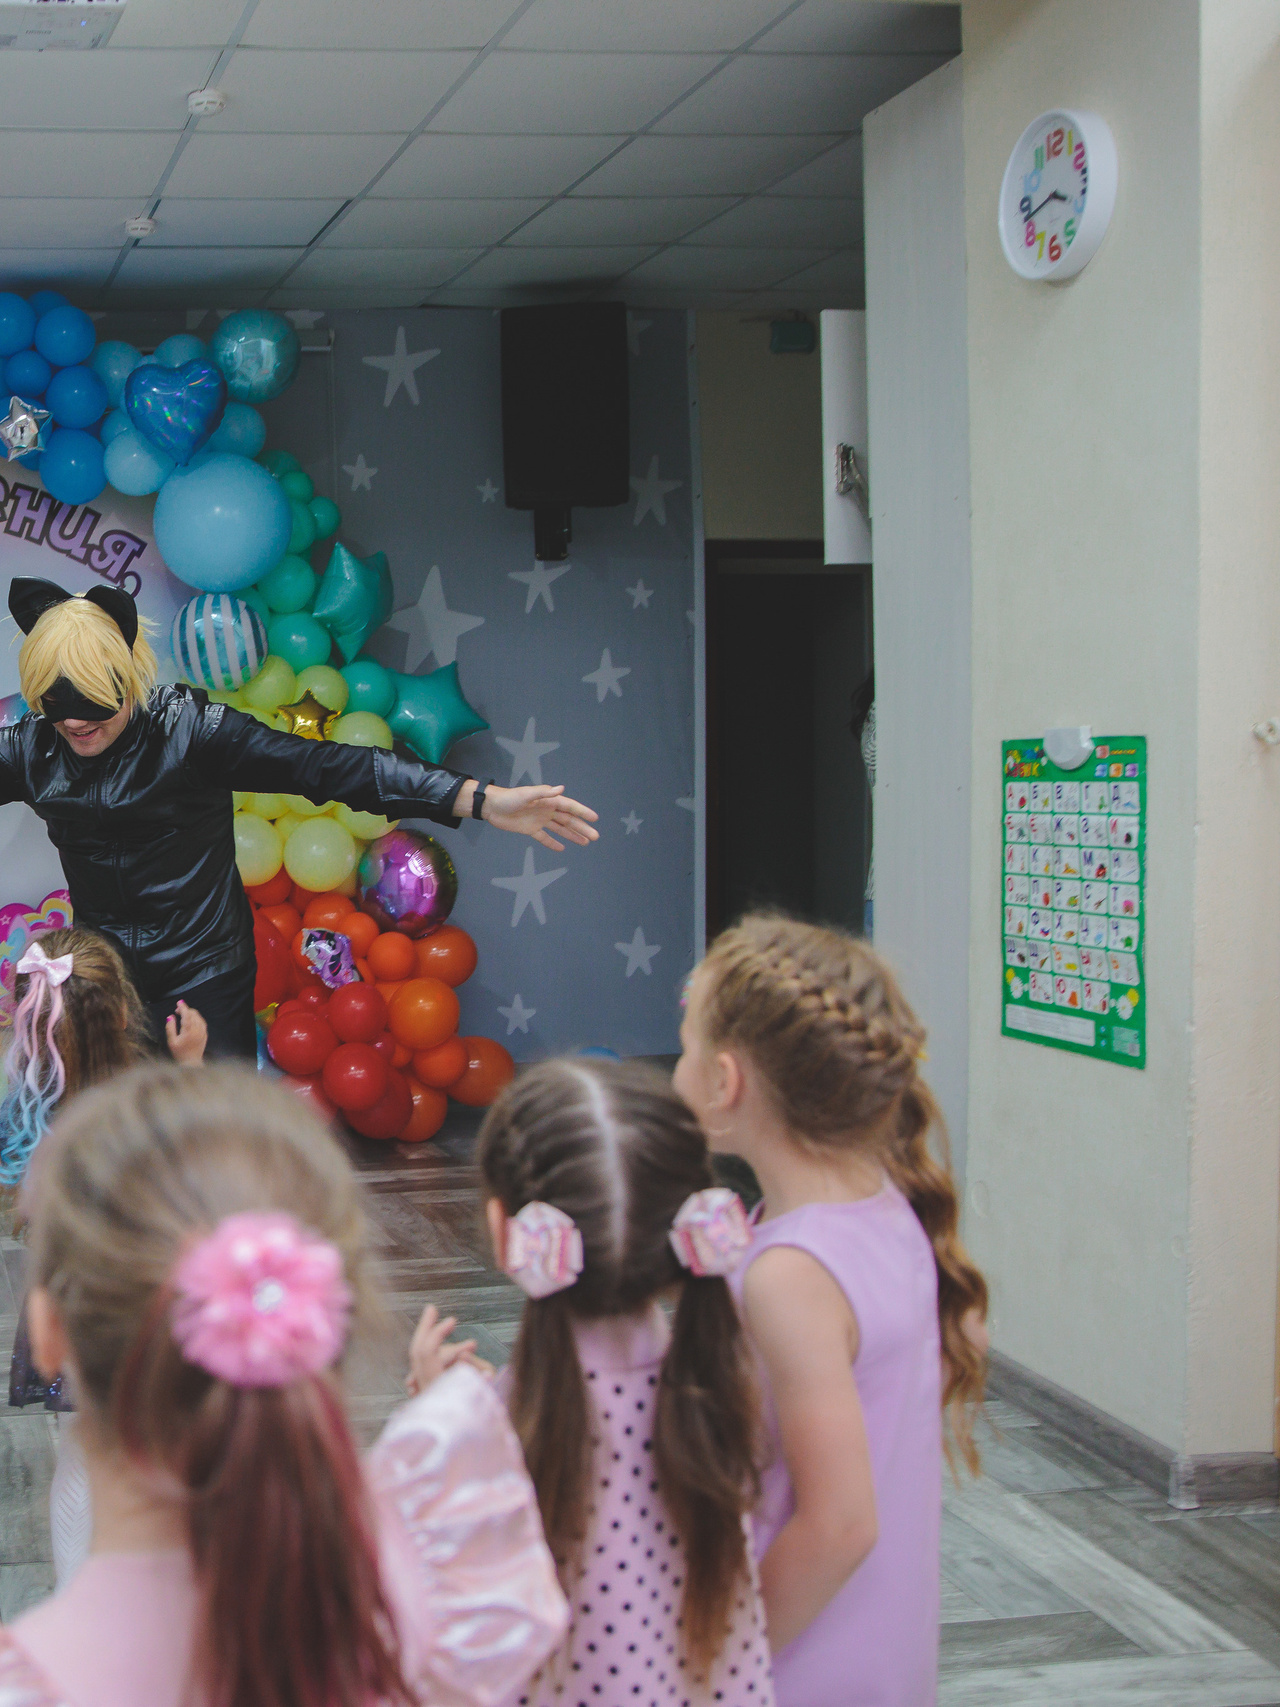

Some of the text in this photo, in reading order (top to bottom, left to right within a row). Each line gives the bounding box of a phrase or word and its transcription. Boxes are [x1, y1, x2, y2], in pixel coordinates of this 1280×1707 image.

[1046, 128, 1064, 162] 12
[1067, 129, 1073, 156] 1
[1073, 141, 1085, 170] 2
[1034, 145, 1044, 170] 11
[1024, 168, 1041, 193] 10
[1020, 195, 1032, 218] 9
[1025, 221, 1036, 247] 8
[1035, 231, 1046, 261] 7
[1064, 218, 1076, 247] 5
[1049, 233, 1062, 262] 6
